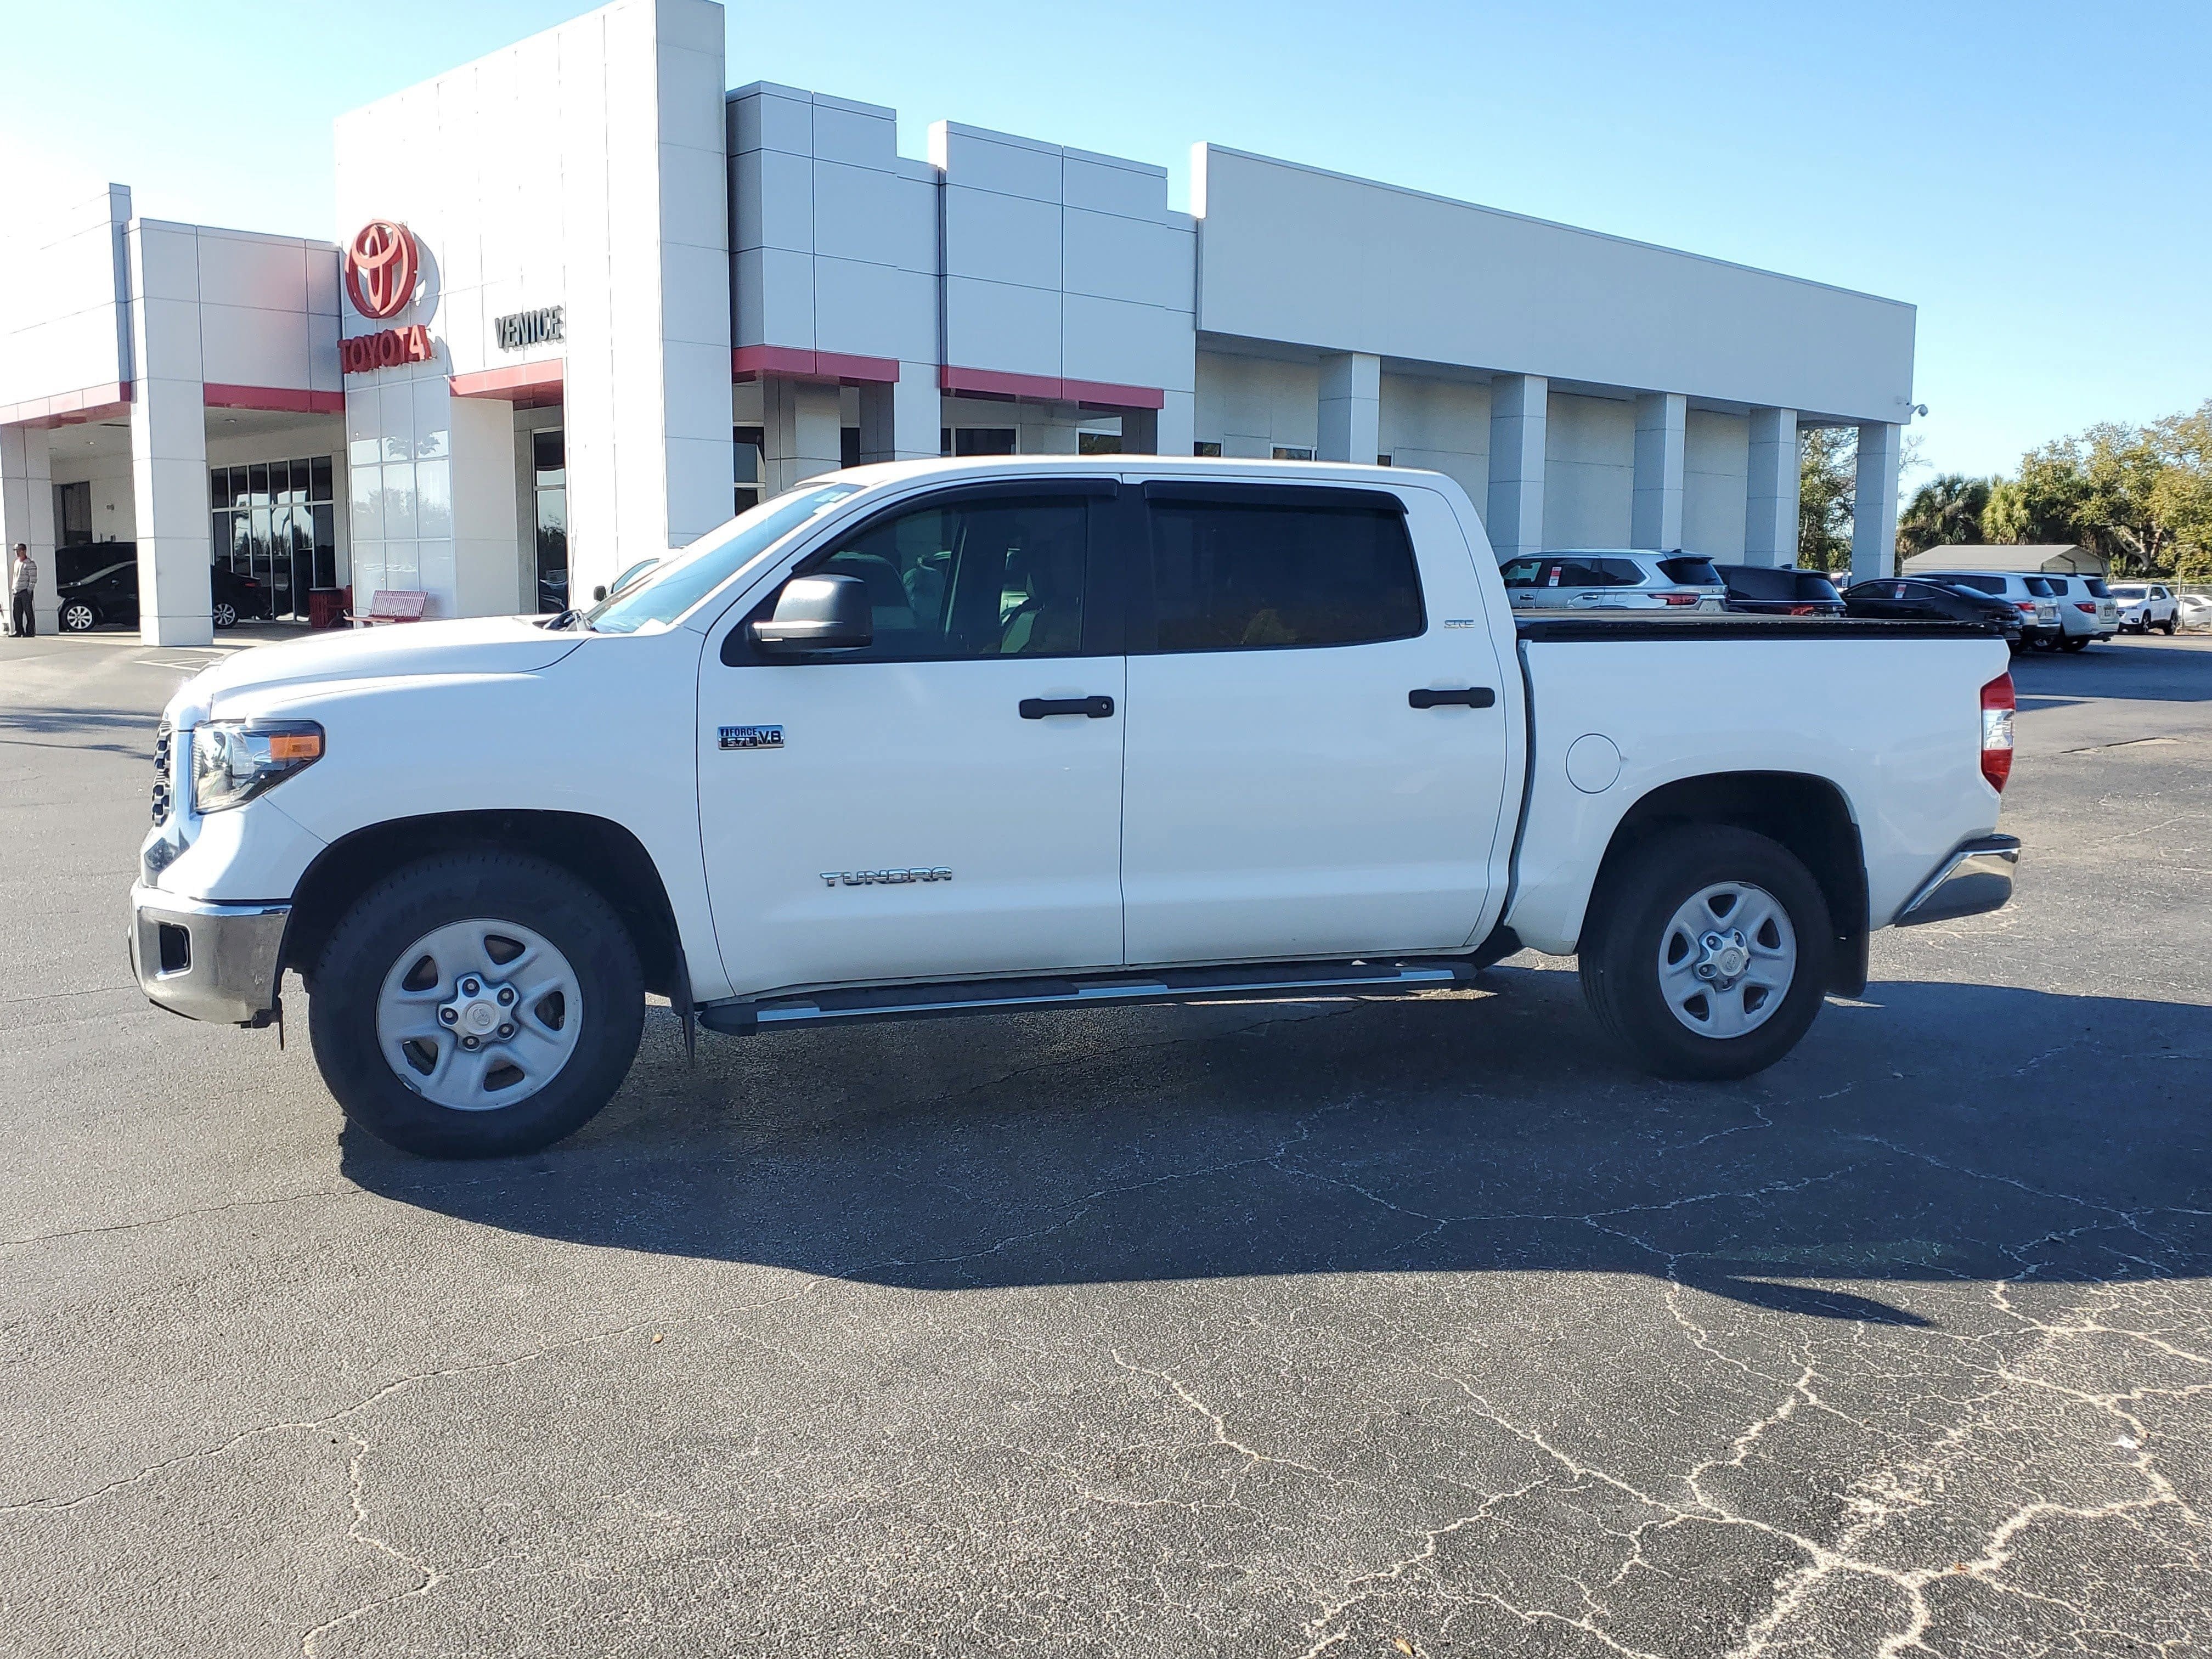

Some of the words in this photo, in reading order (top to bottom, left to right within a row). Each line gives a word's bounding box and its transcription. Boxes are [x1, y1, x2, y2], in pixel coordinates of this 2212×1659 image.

[494, 305, 562, 348] VENICE
[337, 324, 432, 374] TOYOTA
[758, 730, 781, 744] V8
[820, 866, 952, 887] TUNDRA
